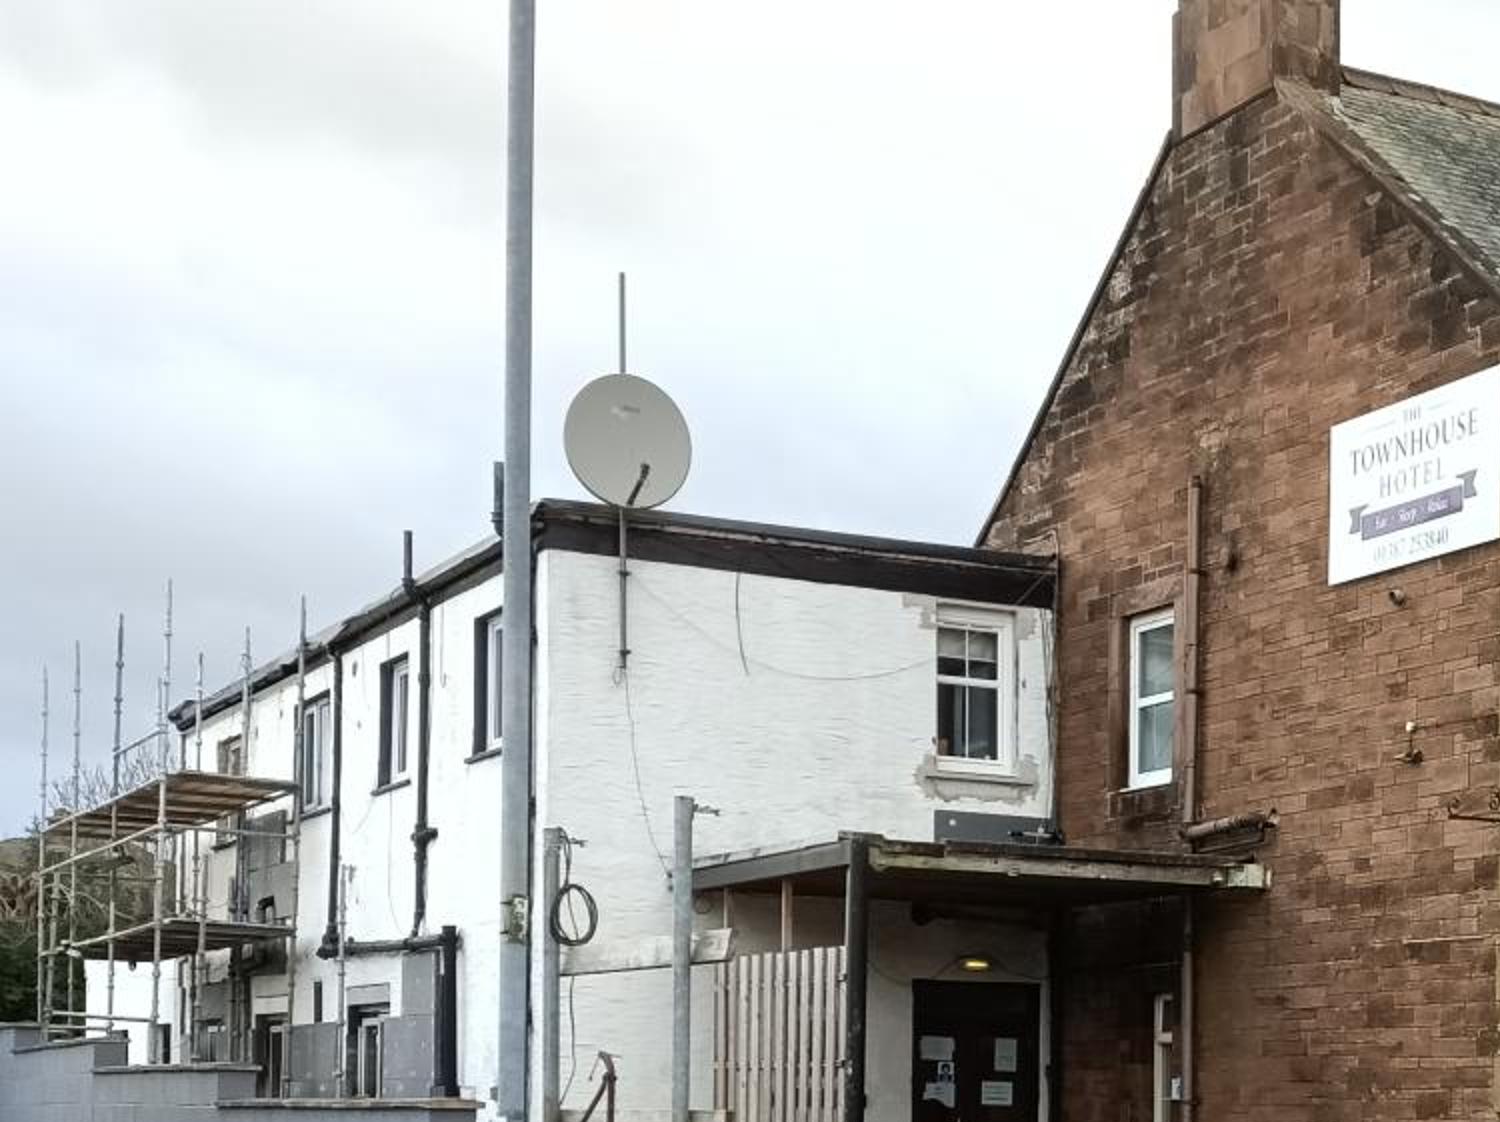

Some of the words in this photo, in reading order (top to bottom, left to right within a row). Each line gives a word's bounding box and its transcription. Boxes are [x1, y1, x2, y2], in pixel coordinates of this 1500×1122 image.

[1402, 406, 1422, 423] THE
[1349, 407, 1480, 477] TOWNHOUSE
[1378, 455, 1446, 499] HOTEL
